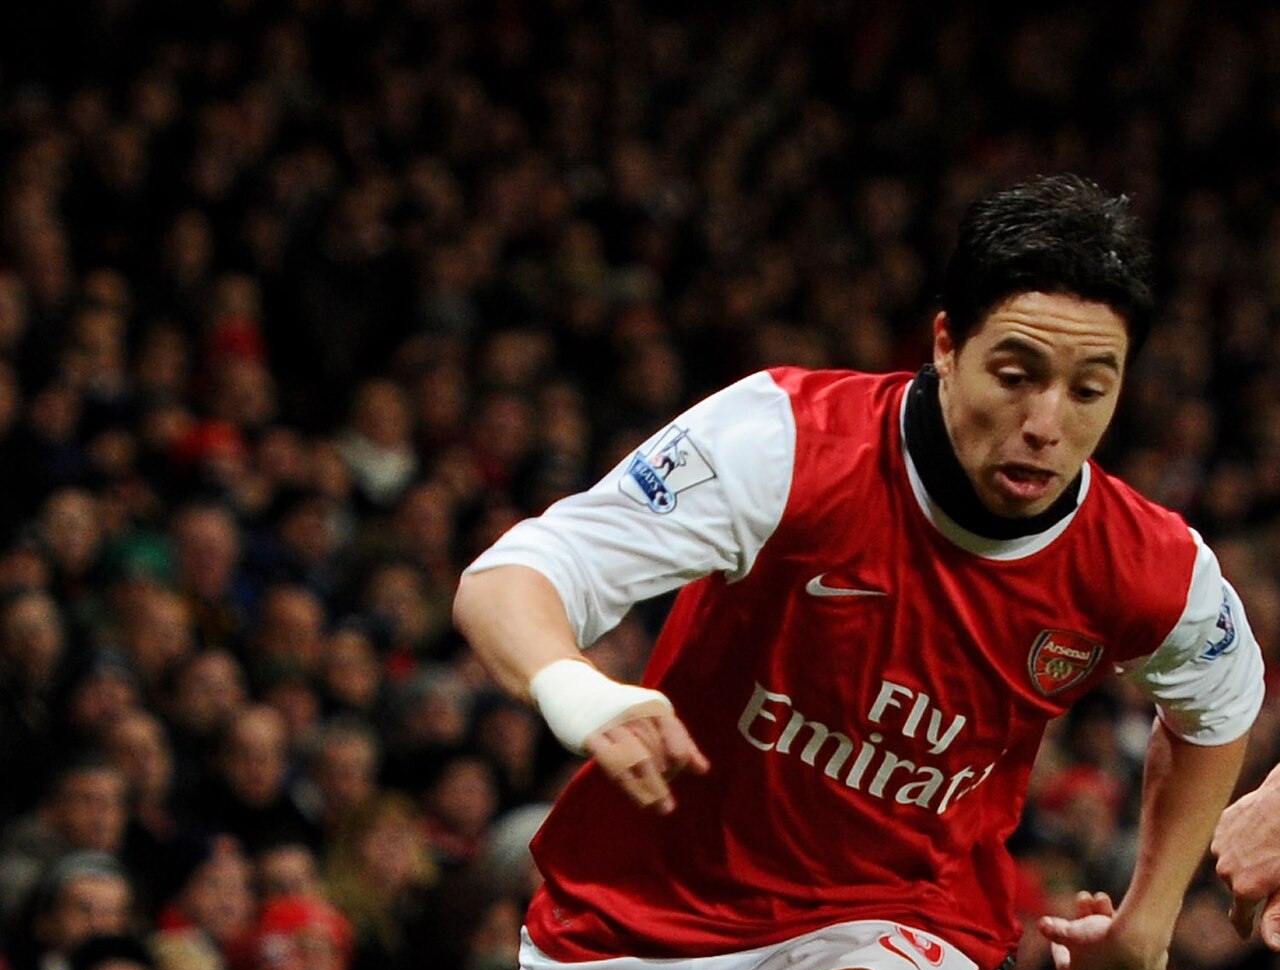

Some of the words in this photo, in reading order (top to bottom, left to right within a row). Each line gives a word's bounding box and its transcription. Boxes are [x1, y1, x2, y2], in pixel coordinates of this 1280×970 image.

[1043, 641, 1091, 661] Arsenal
[737, 679, 996, 815] Emirat
[867, 680, 967, 755] Fly
